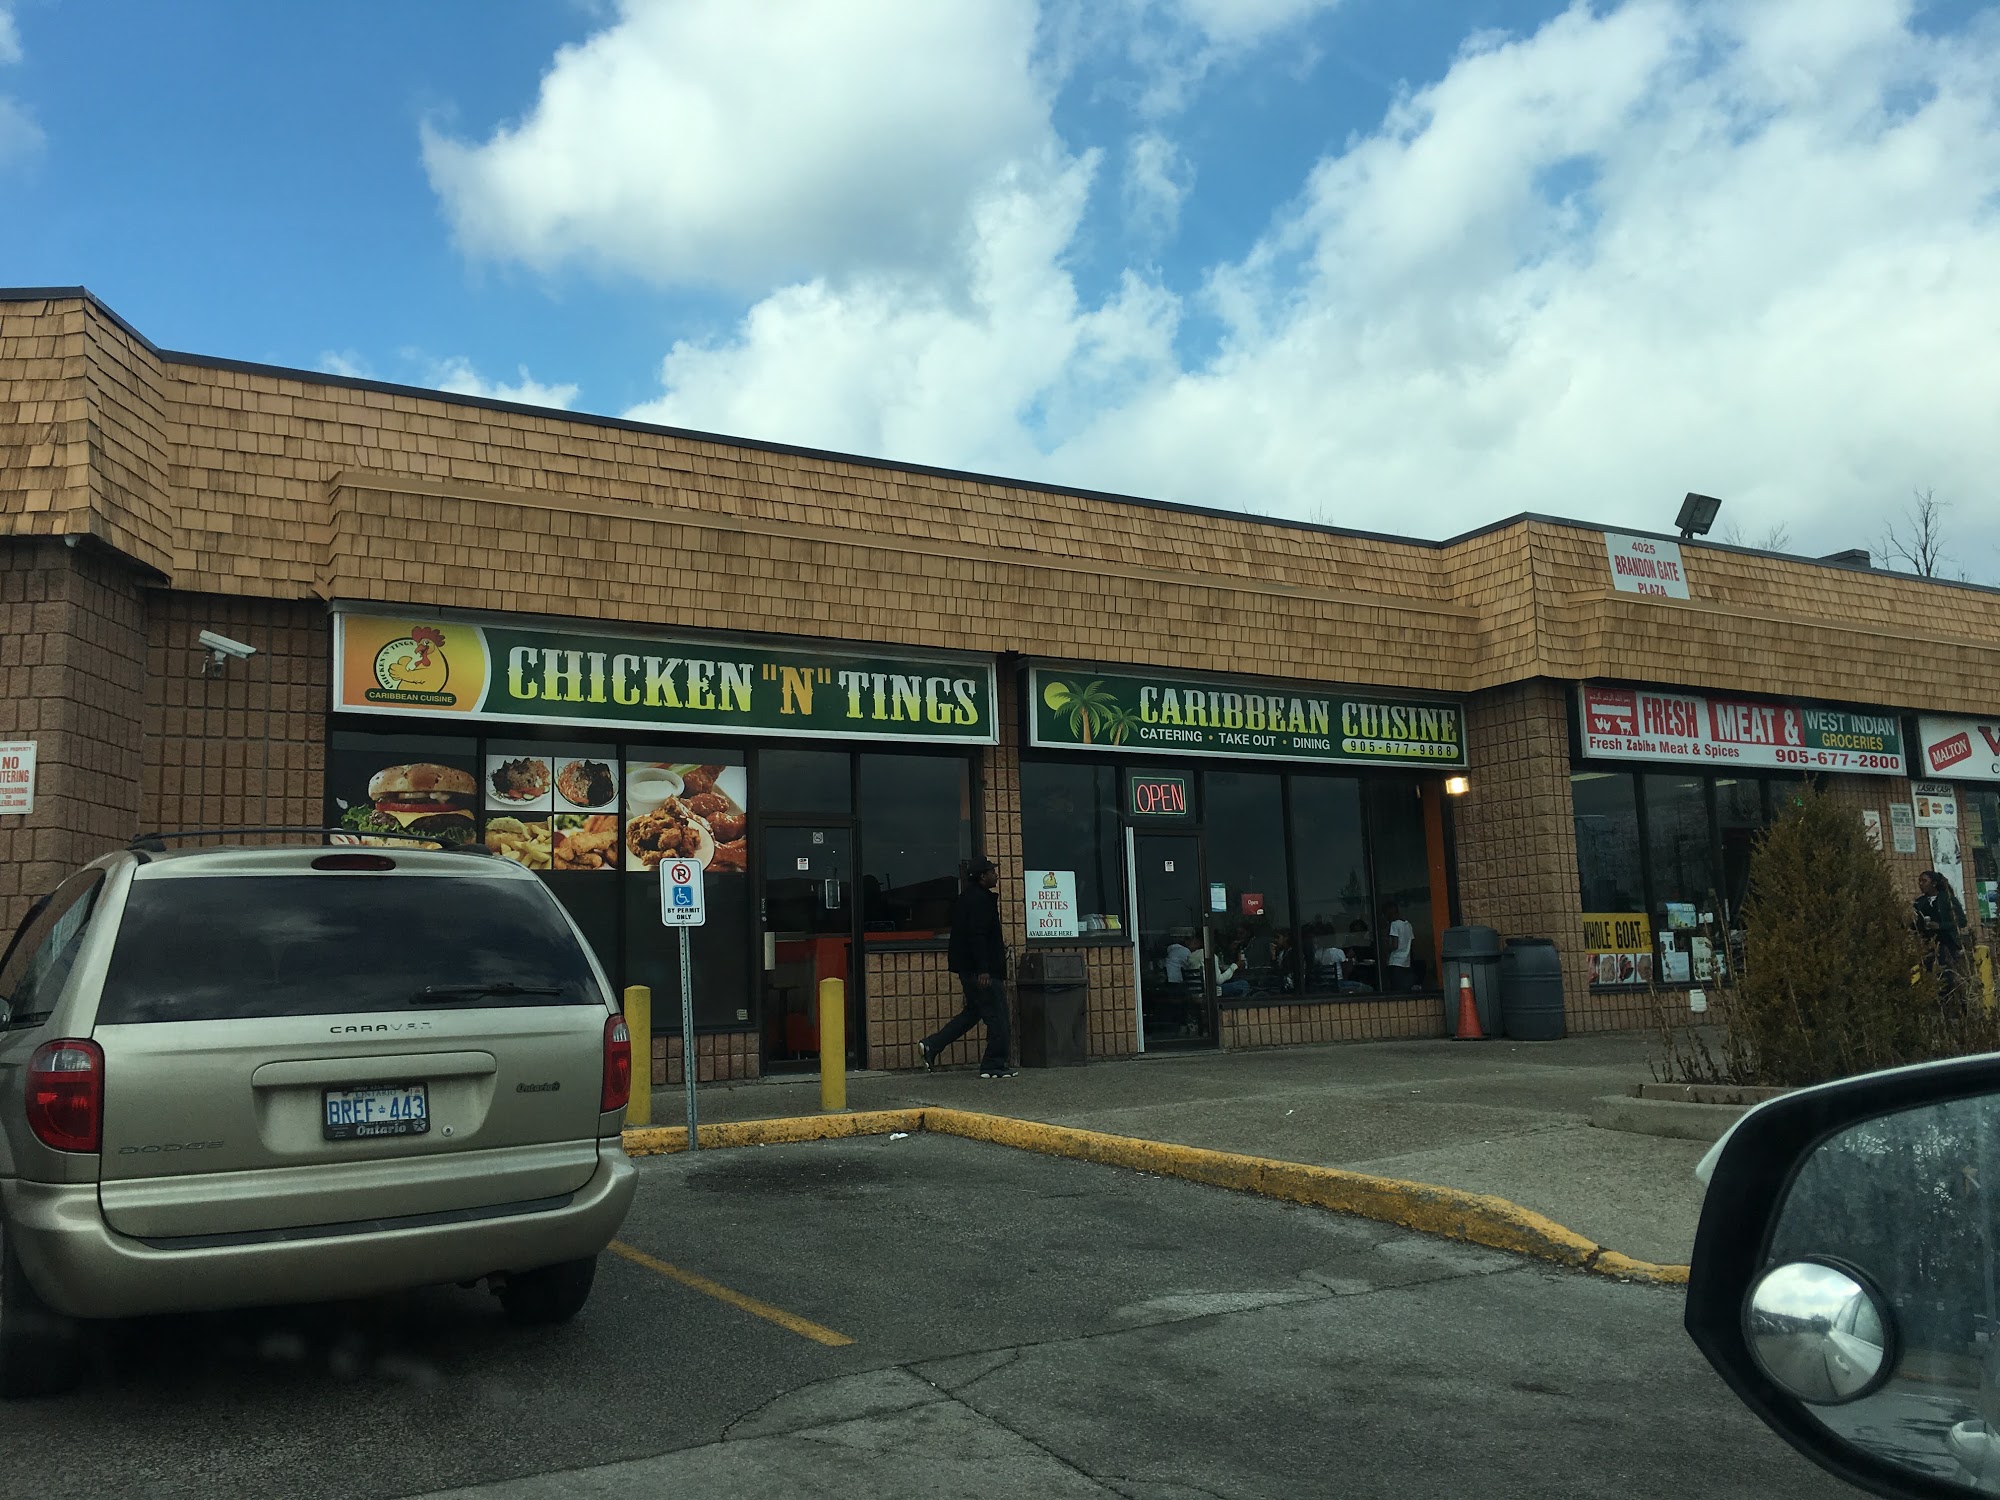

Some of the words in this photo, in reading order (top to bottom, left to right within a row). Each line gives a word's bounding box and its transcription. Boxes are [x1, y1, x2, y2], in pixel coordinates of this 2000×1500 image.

[1632, 542, 1655, 554] 4025
[1614, 555, 1657, 578] BRANDON
[1657, 560, 1679, 581] GATE
[1637, 582, 1668, 597] PLAZA
[379, 658, 393, 688] CHICKEN
[390, 641, 414, 650] TINGS
[507, 645, 754, 713] CHICKEN
[762, 664, 831, 715] "N"
[837, 669, 978, 725] TINGS
[369, 691, 419, 701] CARIBBEAN
[420, 694, 453, 703] CUISINE
[1139, 686, 1329, 735] CARIBBEAN
[1342, 701, 1457, 742] CUISINE
[1642, 696, 1699, 738] FRESH
[1715, 704, 1775, 744] MEAT
[1783, 709, 1800, 745] &
[1805, 710, 1845, 732] WEST
[1851, 714, 1895, 736] INDIAN
[1140, 727, 1202, 743] CATERING
[1219, 732, 1250, 745] TAKE
[1252, 734, 1276, 747] OUT
[1293, 737, 1330, 750] DINING
[1350, 740, 1453, 757] 905-677-9888
[1589, 736, 1622, 750] Fresh
[1626, 739, 1656, 752] Zabiha
[1659, 741, 1688, 755] Meat
[1692, 743, 1701, 755] &
[1704, 744, 1740, 758] Spices
[1821, 733, 1884, 751] GROCERIES
[2, 756, 19, 769] NO
[1775, 749, 1899, 769] 905-677-2800
[1932, 739, 1968, 765] MALTON
[1136, 784, 1184, 812] OPEN
[1031, 901, 1069, 910] PATTIES
[1038, 891, 1061, 900] BEEF
[1039, 919, 1062, 928] ROTI
[1583, 921, 1612, 949] WHOLE
[1615, 921, 1642, 949] GOAT
[328, 1098, 376, 1125] BREF
[390, 1096, 424, 1120] 443
[356, 1123, 407, 1136] Ontario
[118, 1140, 224, 1155] DODGE
